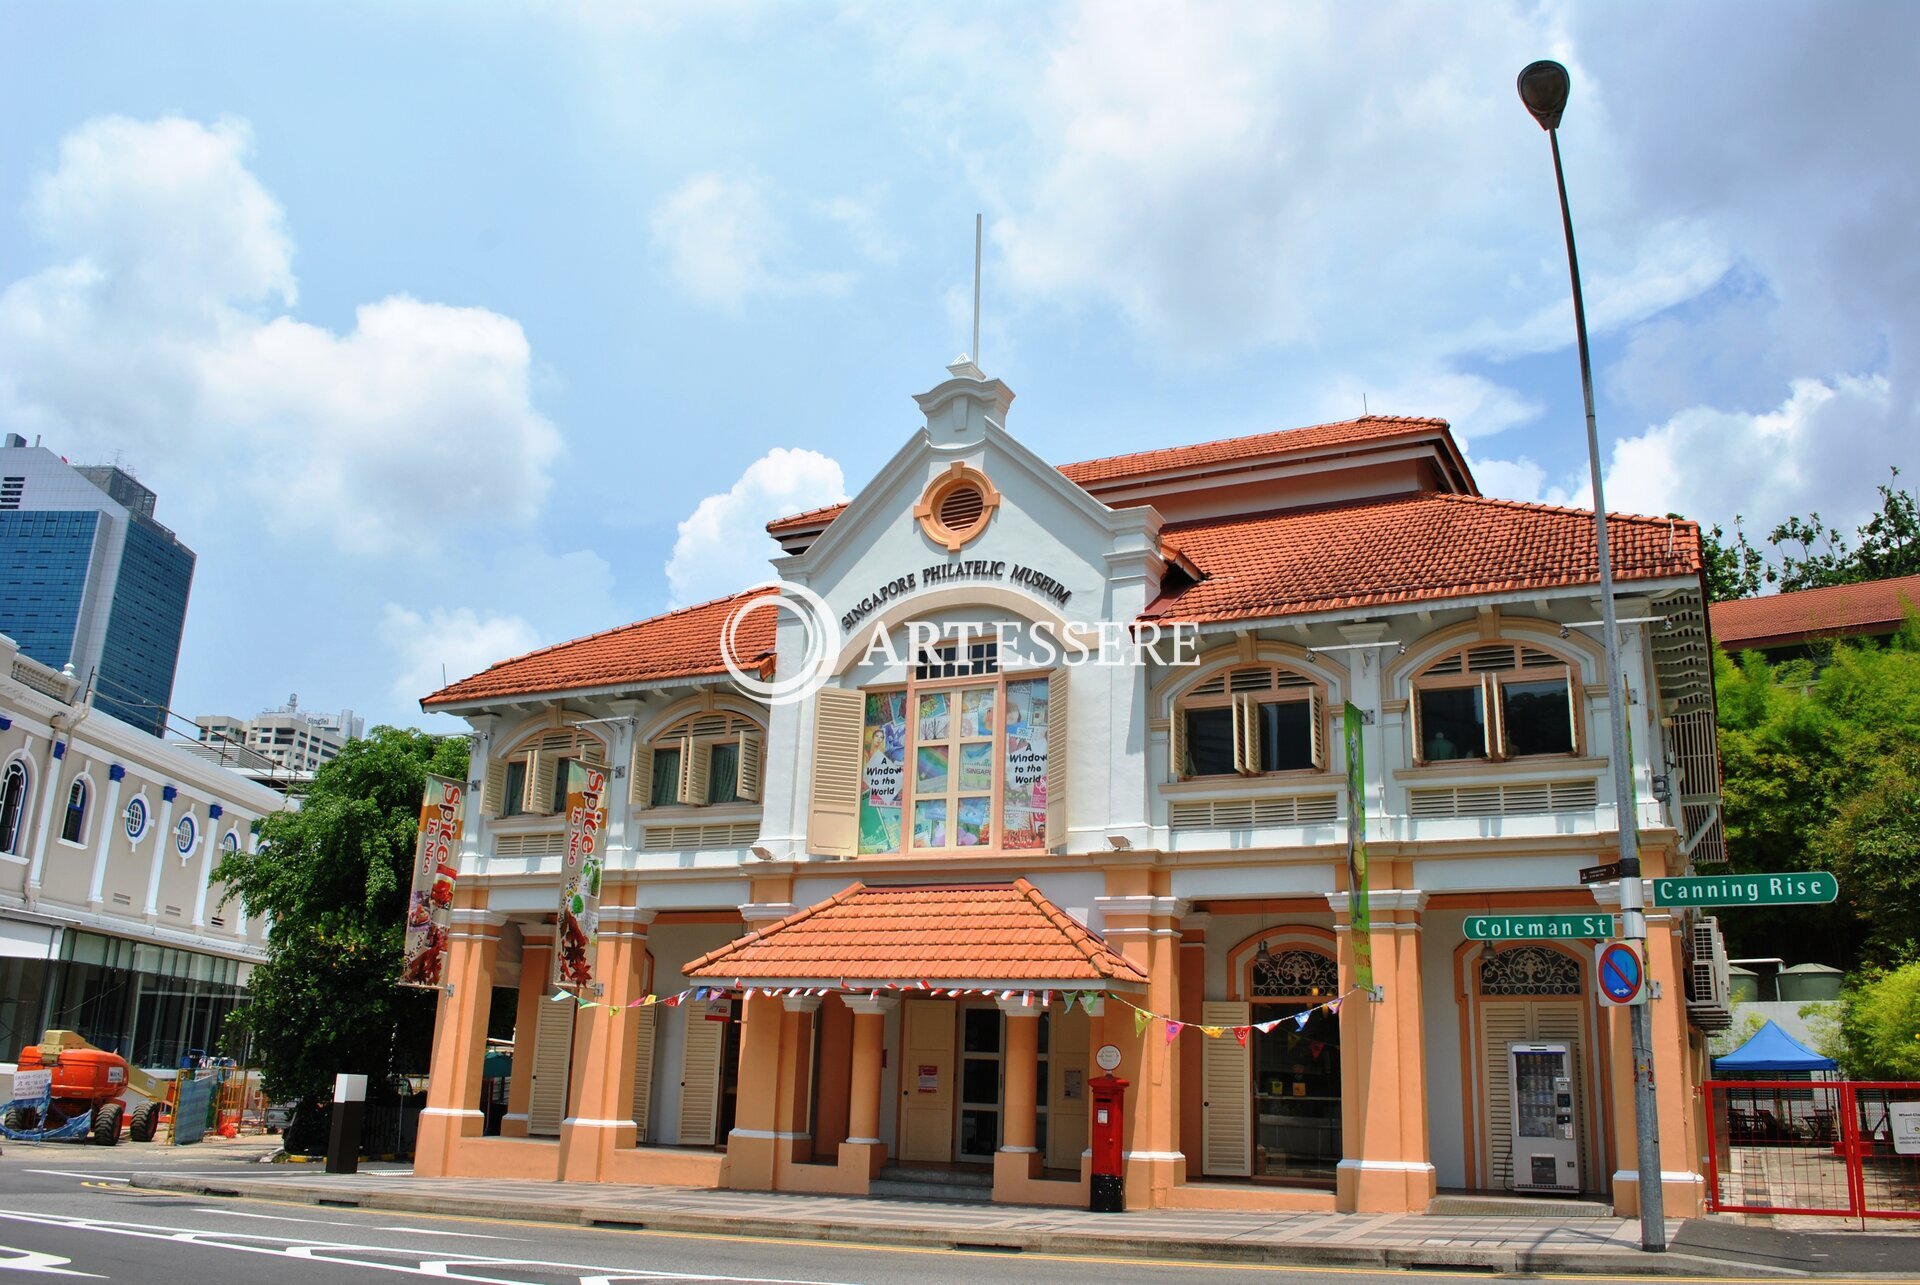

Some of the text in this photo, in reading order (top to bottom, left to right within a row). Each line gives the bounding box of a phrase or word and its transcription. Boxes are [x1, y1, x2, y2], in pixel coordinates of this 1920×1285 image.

[841, 560, 1072, 627] SINGAPORE PHILATELIC MUSEUM
[1025, 743, 1032, 752] A
[881, 757, 887, 765] A
[1008, 754, 1048, 763] Window
[866, 766, 902, 776] Window
[1014, 765, 1042, 773] to the
[870, 778, 896, 786] to the
[1015, 775, 1041, 785] World
[871, 787, 895, 796] World
[573, 809, 582, 824] Is
[581, 770, 605, 854] Spice
[428, 820, 438, 835] Is
[436, 783, 461, 863] Spice
[1660, 877, 1823, 901] Canning Rise
[1475, 917, 1607, 937] Coleman St
